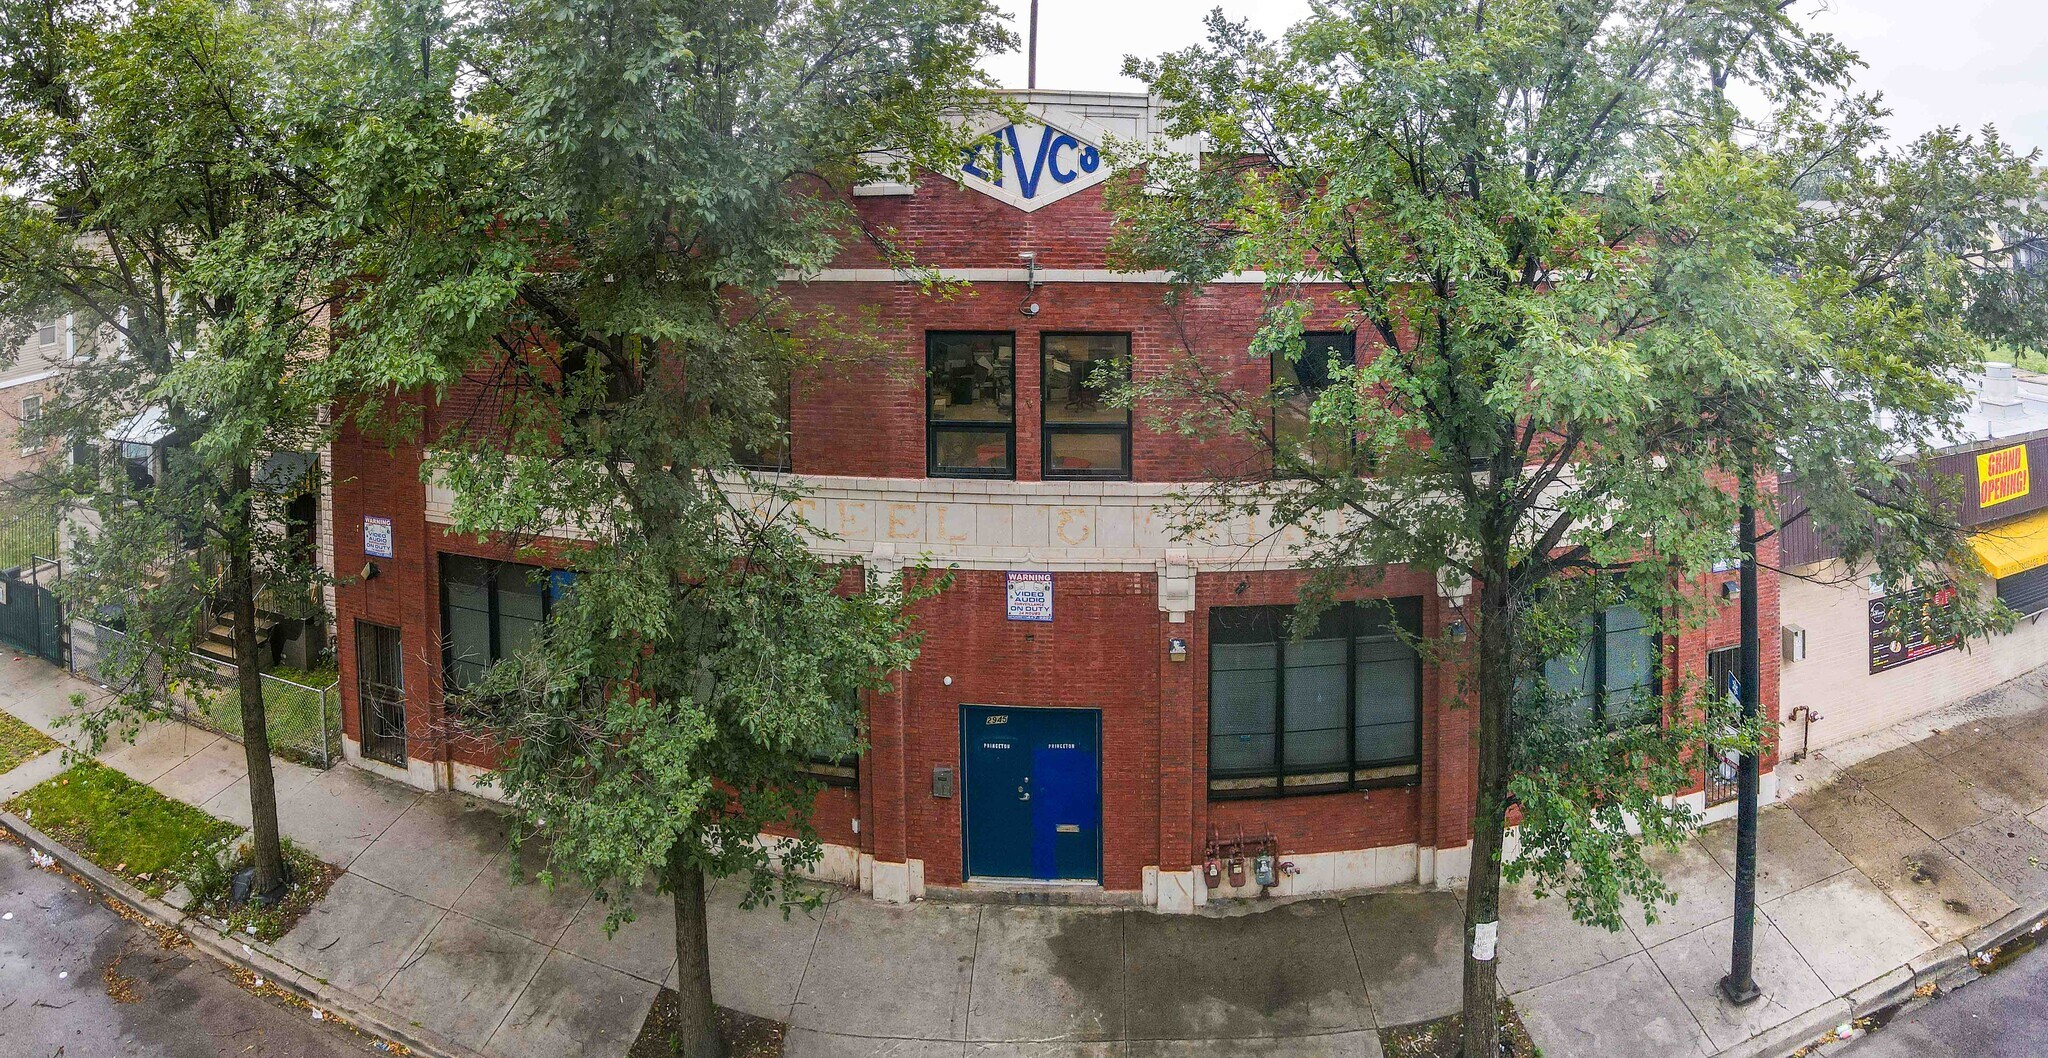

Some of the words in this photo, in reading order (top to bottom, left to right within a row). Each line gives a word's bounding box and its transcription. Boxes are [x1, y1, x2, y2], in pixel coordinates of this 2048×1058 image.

[1988, 447, 2021, 477] GRAND
[1981, 469, 2027, 503] OPENING!
[365, 517, 391, 525] WARNING
[1008, 573, 1051, 581] WARNING
[986, 715, 1008, 724] 2945
